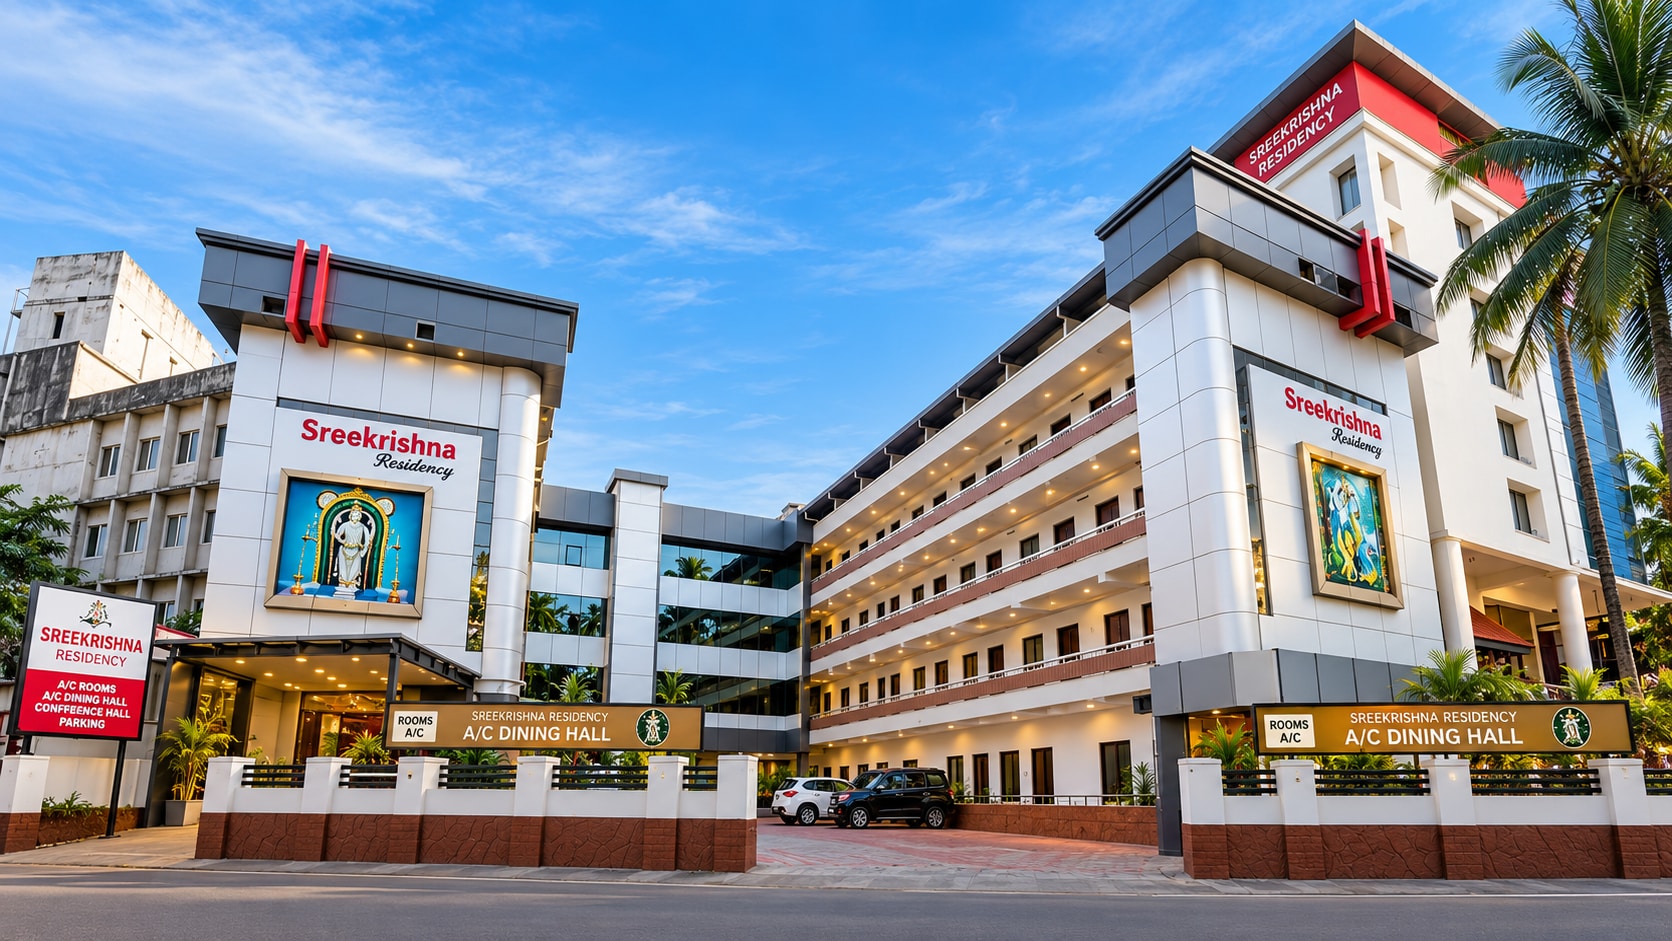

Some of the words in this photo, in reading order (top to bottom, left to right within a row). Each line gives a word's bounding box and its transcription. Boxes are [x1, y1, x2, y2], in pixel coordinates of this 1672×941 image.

[1249, 82, 1343, 165] SREEKRISHNA
[1257, 105, 1335, 177] RESIDENCY
[1284, 386, 1382, 440] Sreekrishna
[301, 418, 457, 460] Sreekrishna
[1331, 427, 1382, 459] Residency
[373, 452, 455, 481] Residency
[40, 626, 144, 654] SREEKRISHNA
[55, 649, 127, 667] RESIDENCY
[57, 680, 77, 690] A/C
[78, 682, 117, 694] ROOMS
[42, 691, 62, 701] A/C
[63, 692, 100, 705] DINING
[102, 696, 128, 707] HALL
[105, 708, 131, 719] HALL
[398, 716, 433, 726] ROOMS
[471, 710, 546, 722] SREEKRISHNA
[549, 711, 609, 723] RESIDENCY
[1350, 712, 1439, 724] SREEKRISHNA
[1443, 711, 1517, 723] RESIDENCY
[59, 717, 105, 729] PARKING
[1270, 720, 1309, 730] ROOMS
[405, 728, 424, 738] A/C
[462, 725, 494, 742] A/C
[499, 726, 560, 741] DINING
[566, 726, 611, 742] HALL
[1280, 732, 1301, 743] A/C
[1345, 728, 1380, 746] A/C
[1387, 728, 1461, 745] DINING
[1467, 728, 1524, 744] HALL
